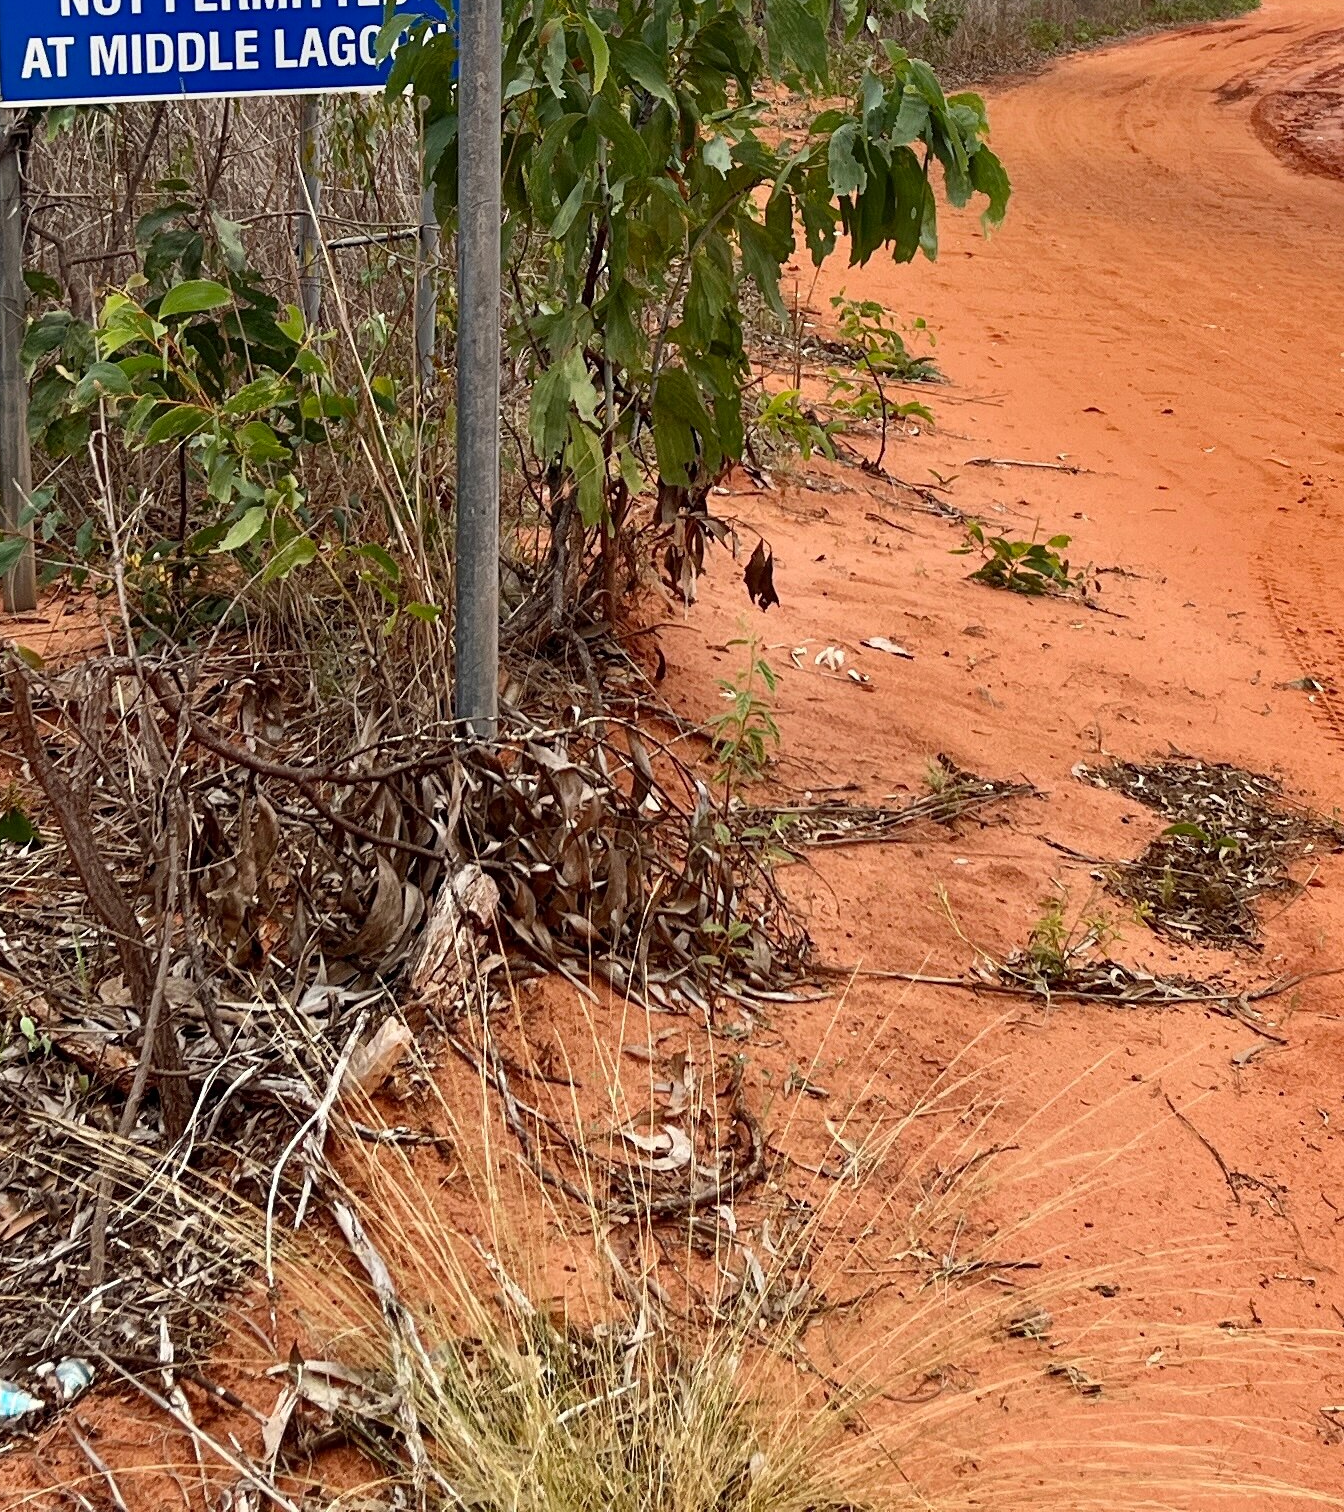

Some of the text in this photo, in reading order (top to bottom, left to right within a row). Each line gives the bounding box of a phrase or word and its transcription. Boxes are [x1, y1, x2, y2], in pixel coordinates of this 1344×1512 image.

[21, 23, 447, 79] AT MIDDLE LAGO
